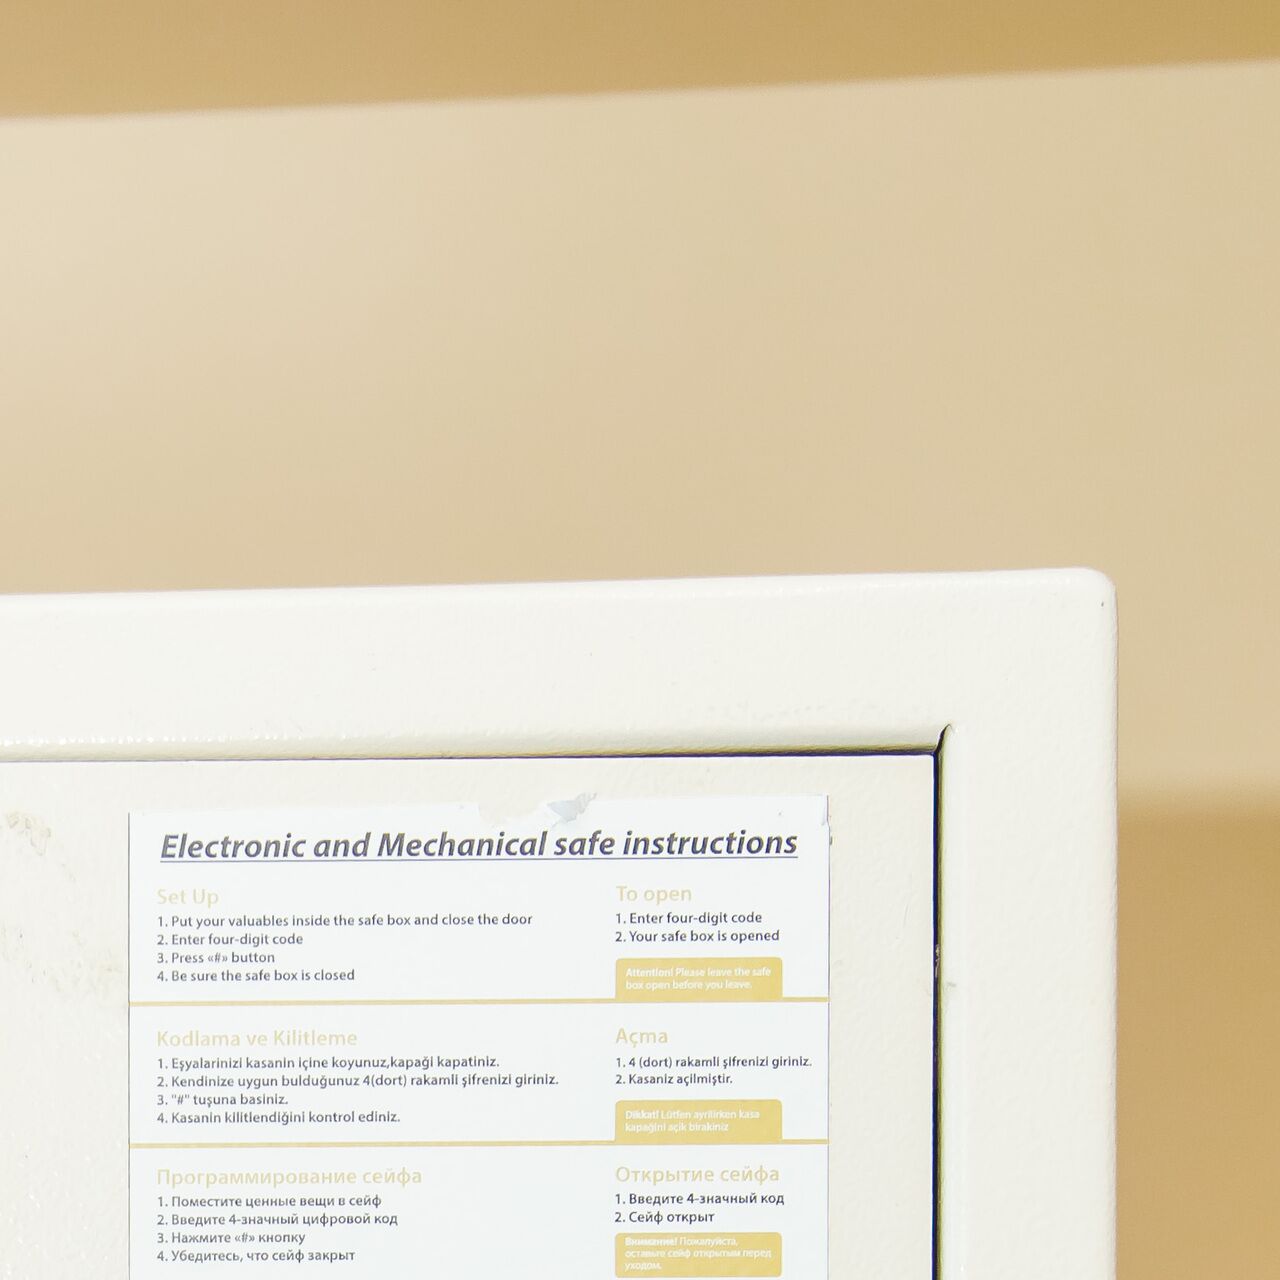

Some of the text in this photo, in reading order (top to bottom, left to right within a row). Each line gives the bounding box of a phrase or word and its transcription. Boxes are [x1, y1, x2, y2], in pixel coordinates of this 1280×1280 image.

[160, 828, 798, 859] Electronic and Mechanical safe instructions
[156, 888, 219, 910] Set Up
[615, 885, 693, 907] To open
[157, 912, 533, 931] 1. Put your valuables inside the safe box and close the door
[615, 910, 763, 927] 1. Enter four-digit code
[156, 931, 304, 948] 2. Enter four-digit code
[614, 928, 780, 945] 2. Your safe box is opened
[156, 952, 169, 964] 3.
[171, 952, 205, 964] Press
[231, 950, 276, 964] button
[156, 968, 355, 983] 4. Be sure the safe box is closed
[157, 1028, 358, 1048] Kodlama ve Kilitleme
[615, 1027, 669, 1049] Açma
[157, 1057, 169, 1070] 1.
[615, 1057, 626, 1068] 1.
[628, 1056, 637, 1068] 4
[638, 1056, 673, 1070] (dort)
[156, 1076, 169, 1088] 2.
[237, 1077, 278, 1090] uygun
[281, 1073, 360, 1090] bulduğunuz
[615, 1073, 626, 1085] 2.
[156, 1094, 169, 1106] 3.
[192, 1094, 237, 1109] tuşuna
[156, 1112, 169, 1124] 4.
[308, 1110, 355, 1123] kontrol
[157, 1166, 422, 1189] Программирование сейфа
[615, 1164, 780, 1187] Открытие сейфа
[157, 1194, 382, 1210] 1. Поместите ценные вещи в сейф
[615, 1191, 785, 1208] 1. Введите 4-значный код
[156, 1212, 399, 1228] 2. Введите 4-значный цифровой код
[614, 1210, 716, 1226] 2. Сейф открыт
[156, 1232, 169, 1244] 3.
[171, 1231, 232, 1244] Нажмите
[258, 1233, 306, 1246] кнопку
[156, 1248, 356, 1265] 4. Убедитесь, что сейф закрыт
